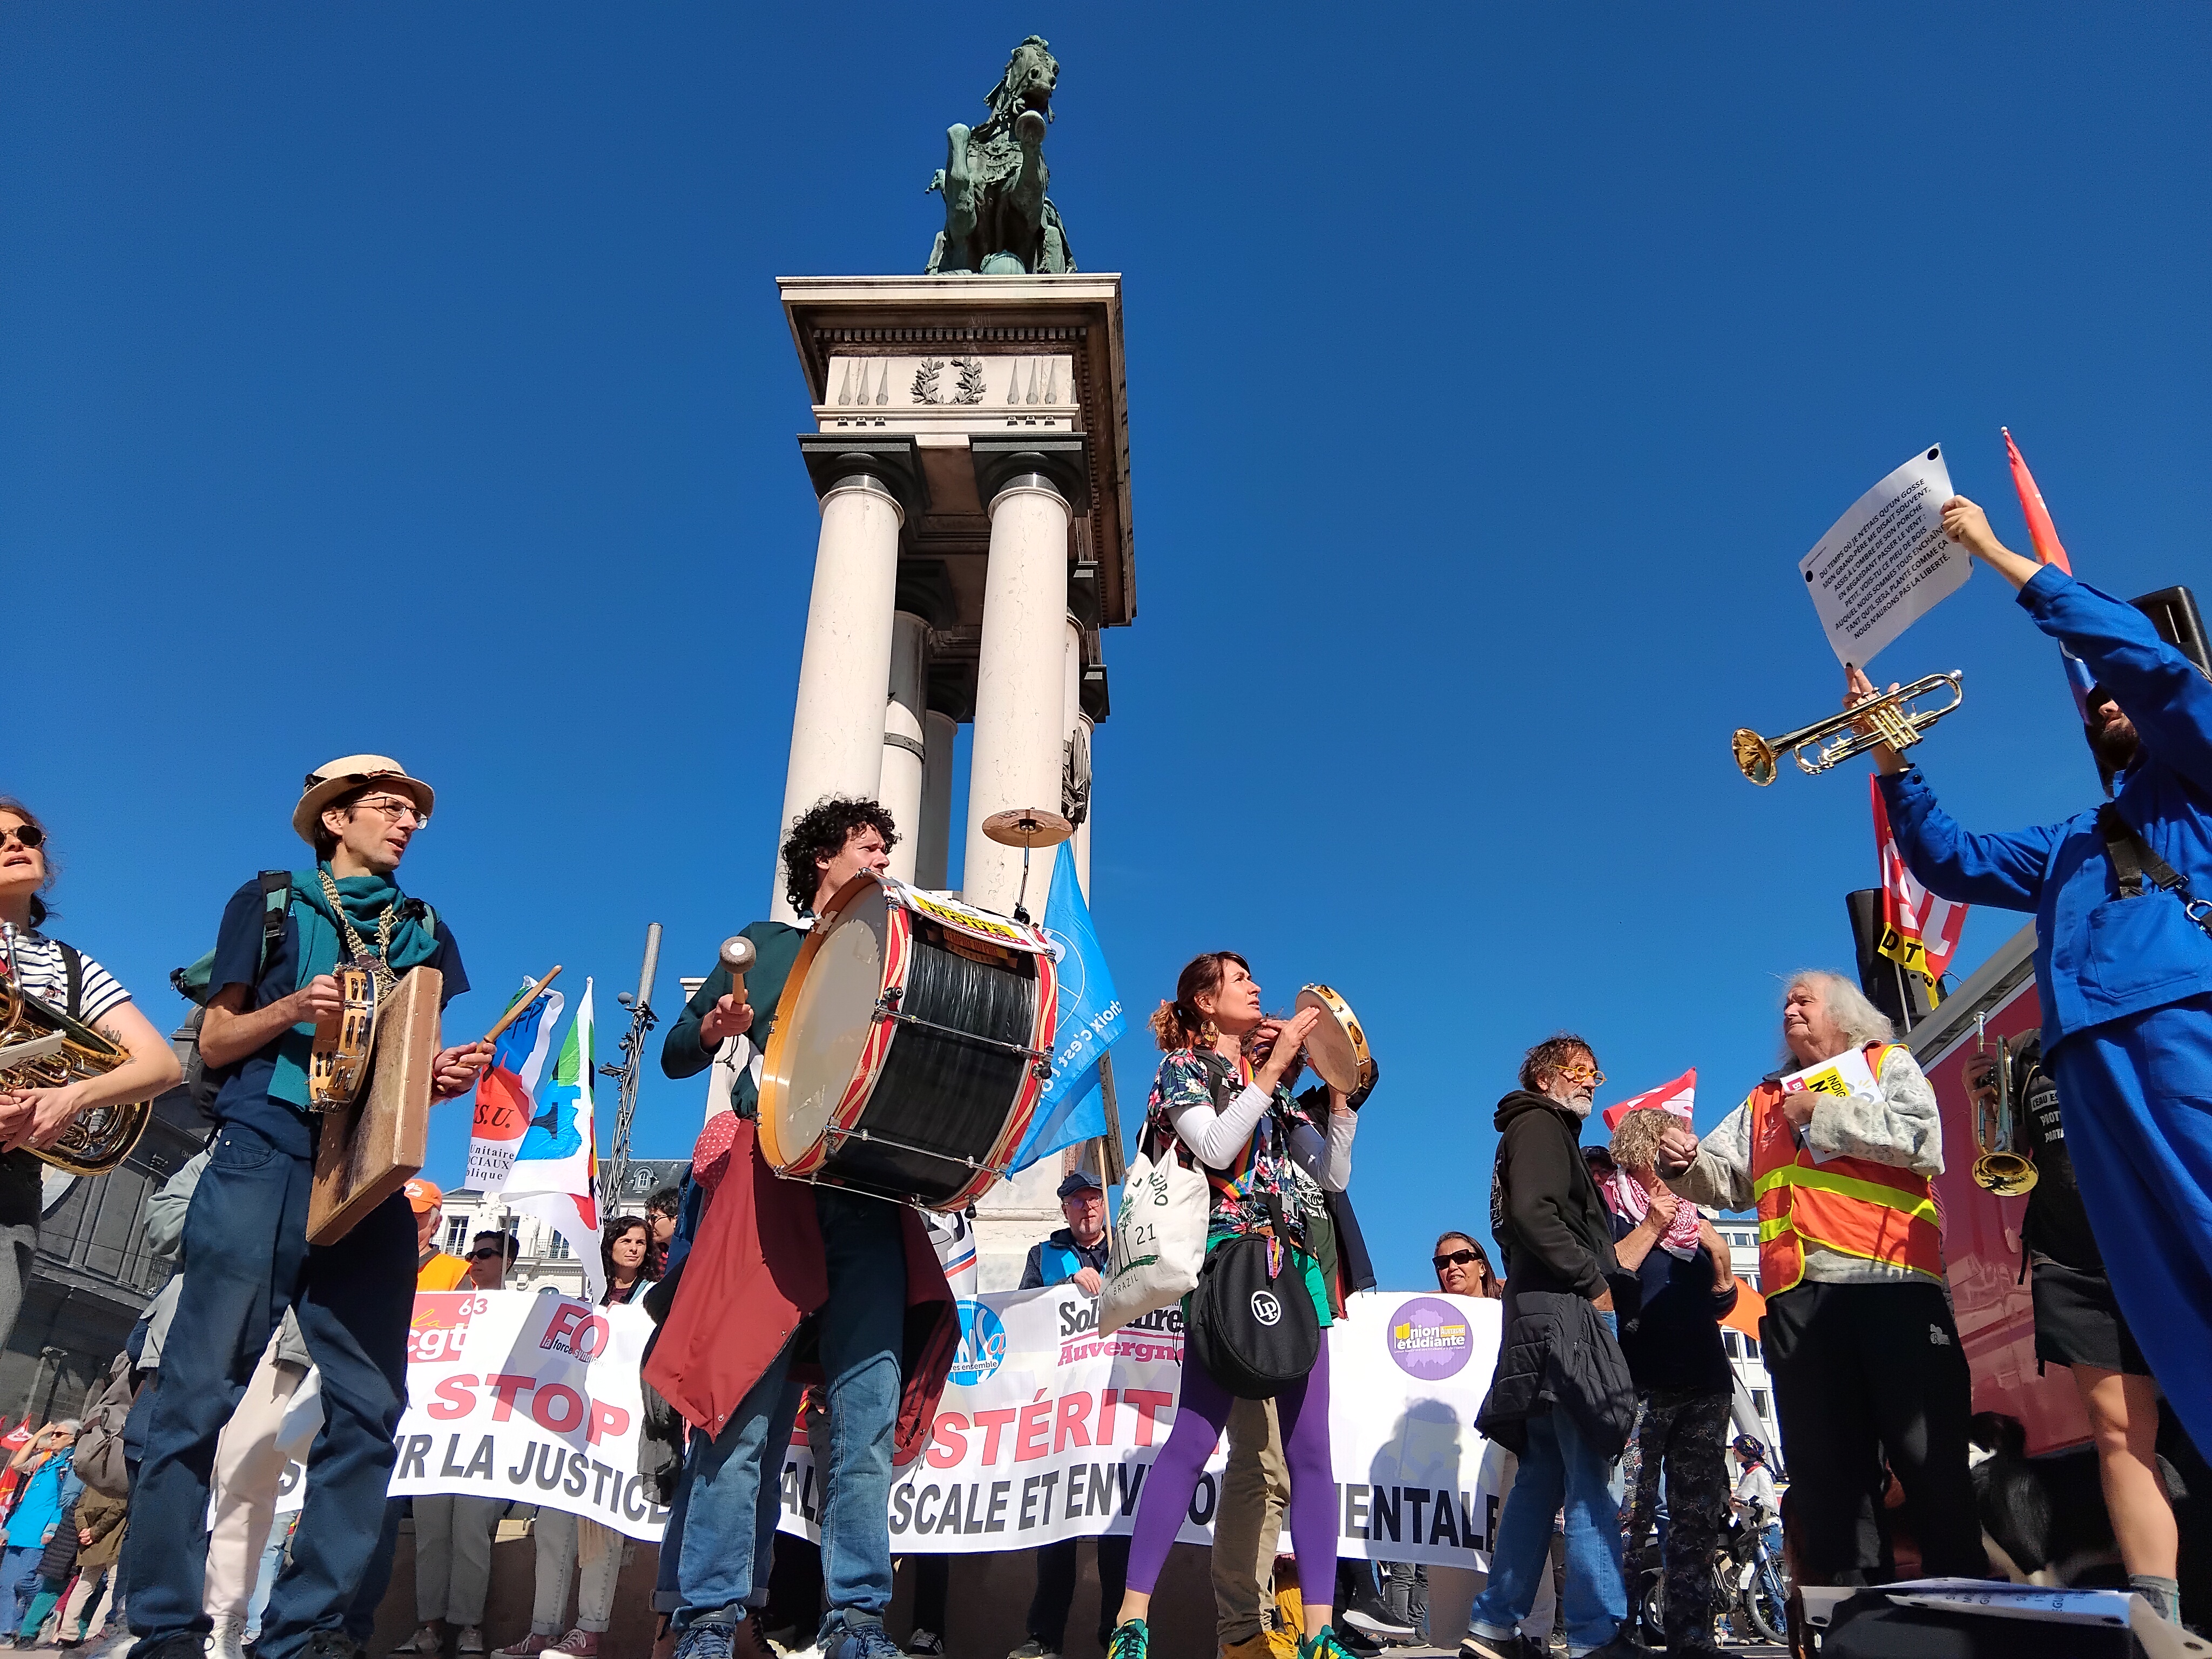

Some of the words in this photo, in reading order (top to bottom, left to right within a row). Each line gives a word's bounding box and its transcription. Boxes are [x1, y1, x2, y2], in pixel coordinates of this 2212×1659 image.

[1819, 568, 1828, 579] DU
[1827, 550, 1844, 570] TEMPS
[1844, 542, 1852, 553] OÙ
[1852, 536, 1859, 547] JE
[1858, 515, 1879, 539] N'ÉTAIS
[1879, 496, 1900, 517] QU'UN
[1901, 478, 1925, 498] GOSSE
[1823, 574, 1836, 590] MON
[1836, 539, 1869, 576] GRAND-PÈRE
[1867, 531, 1878, 543] ME
[1876, 512, 1896, 534] DISAIT
[1896, 487, 1931, 516] SOUVENT,
[1834, 575, 1849, 592] ASSIS
[1848, 569, 1853, 578] À
[1852, 546, 1876, 574] L'OMBRE
[1876, 538, 1884, 549] DE
[1883, 526, 1897, 541] SON
[1896, 502, 1923, 529] PORCHE
[1838, 590, 1846, 601] EN
[1846, 558, 1878, 593] REGARDANT
[1877, 539, 1899, 562] PASSER
[1897, 531, 1906, 541] LE
[1905, 516, 1922, 534] VENT
[1845, 590, 1862, 608] PETIT,
[1859, 569, 1882, 592] VOIS-TU
[1882, 561, 1890, 571] CE
[1889, 548, 1903, 564] PIEU
[1902, 540, 1912, 551] DE
[1911, 525, 1927, 543] BOIS
[1835, 607, 1858, 631] AUQUEL
[1857, 591, 1873, 610] NOUS
[1872, 568, 1897, 595] SOMMES
[1896, 553, 1913, 571] TOUS
[1845, 616, 1861, 633] TANT
[1860, 603, 1877, 619] QU'IL
[1874, 590, 1890, 606] SERA
[1889, 570, 1912, 593] PLANTÉ
[1911, 547, 1939, 576] COMME
[1938, 539, 1949, 551] ÇA
[1853, 622, 1871, 639] NOUS
[1871, 595, 1900, 625] N'AURONS
[1898, 584, 1912, 600] PAS
[1911, 577, 1921, 591] LA
[1920, 553, 1951, 580] LIBERTÉ.
[923, 910, 988, 936] BLOQUONS
[988, 932, 1023, 944] TOUT
[929, 906, 1009, 937] NOUS
[1827, 1074, 1846, 1098] INDIG
[2049, 1093, 2058, 1102] E
[474, 1104, 515, 1129] S.U.
[2039, 1110, 2061, 1127] PROT
[470, 1144, 515, 1160] Unitaire
[466, 1167, 503, 1182] blique
[1135, 1223, 1156, 1246] 21
[1114, 1273, 1139, 1296] BRAZIL
[458, 1298, 488, 1316] 63
[539, 1303, 610, 1363] FO
[542, 1336, 552, 1348] la
[552, 1339, 573, 1354] force
[1395, 1322, 1440, 1341] Union
[1397, 1336, 1465, 1350] étudiante
[962, 1360, 997, 1371] ensemble
[427, 1373, 630, 1447] STOP
[440, 1433, 494, 1480] LA
[889, 1480, 1011, 1535] SCALE
[1018, 1471, 1060, 1532] ET
